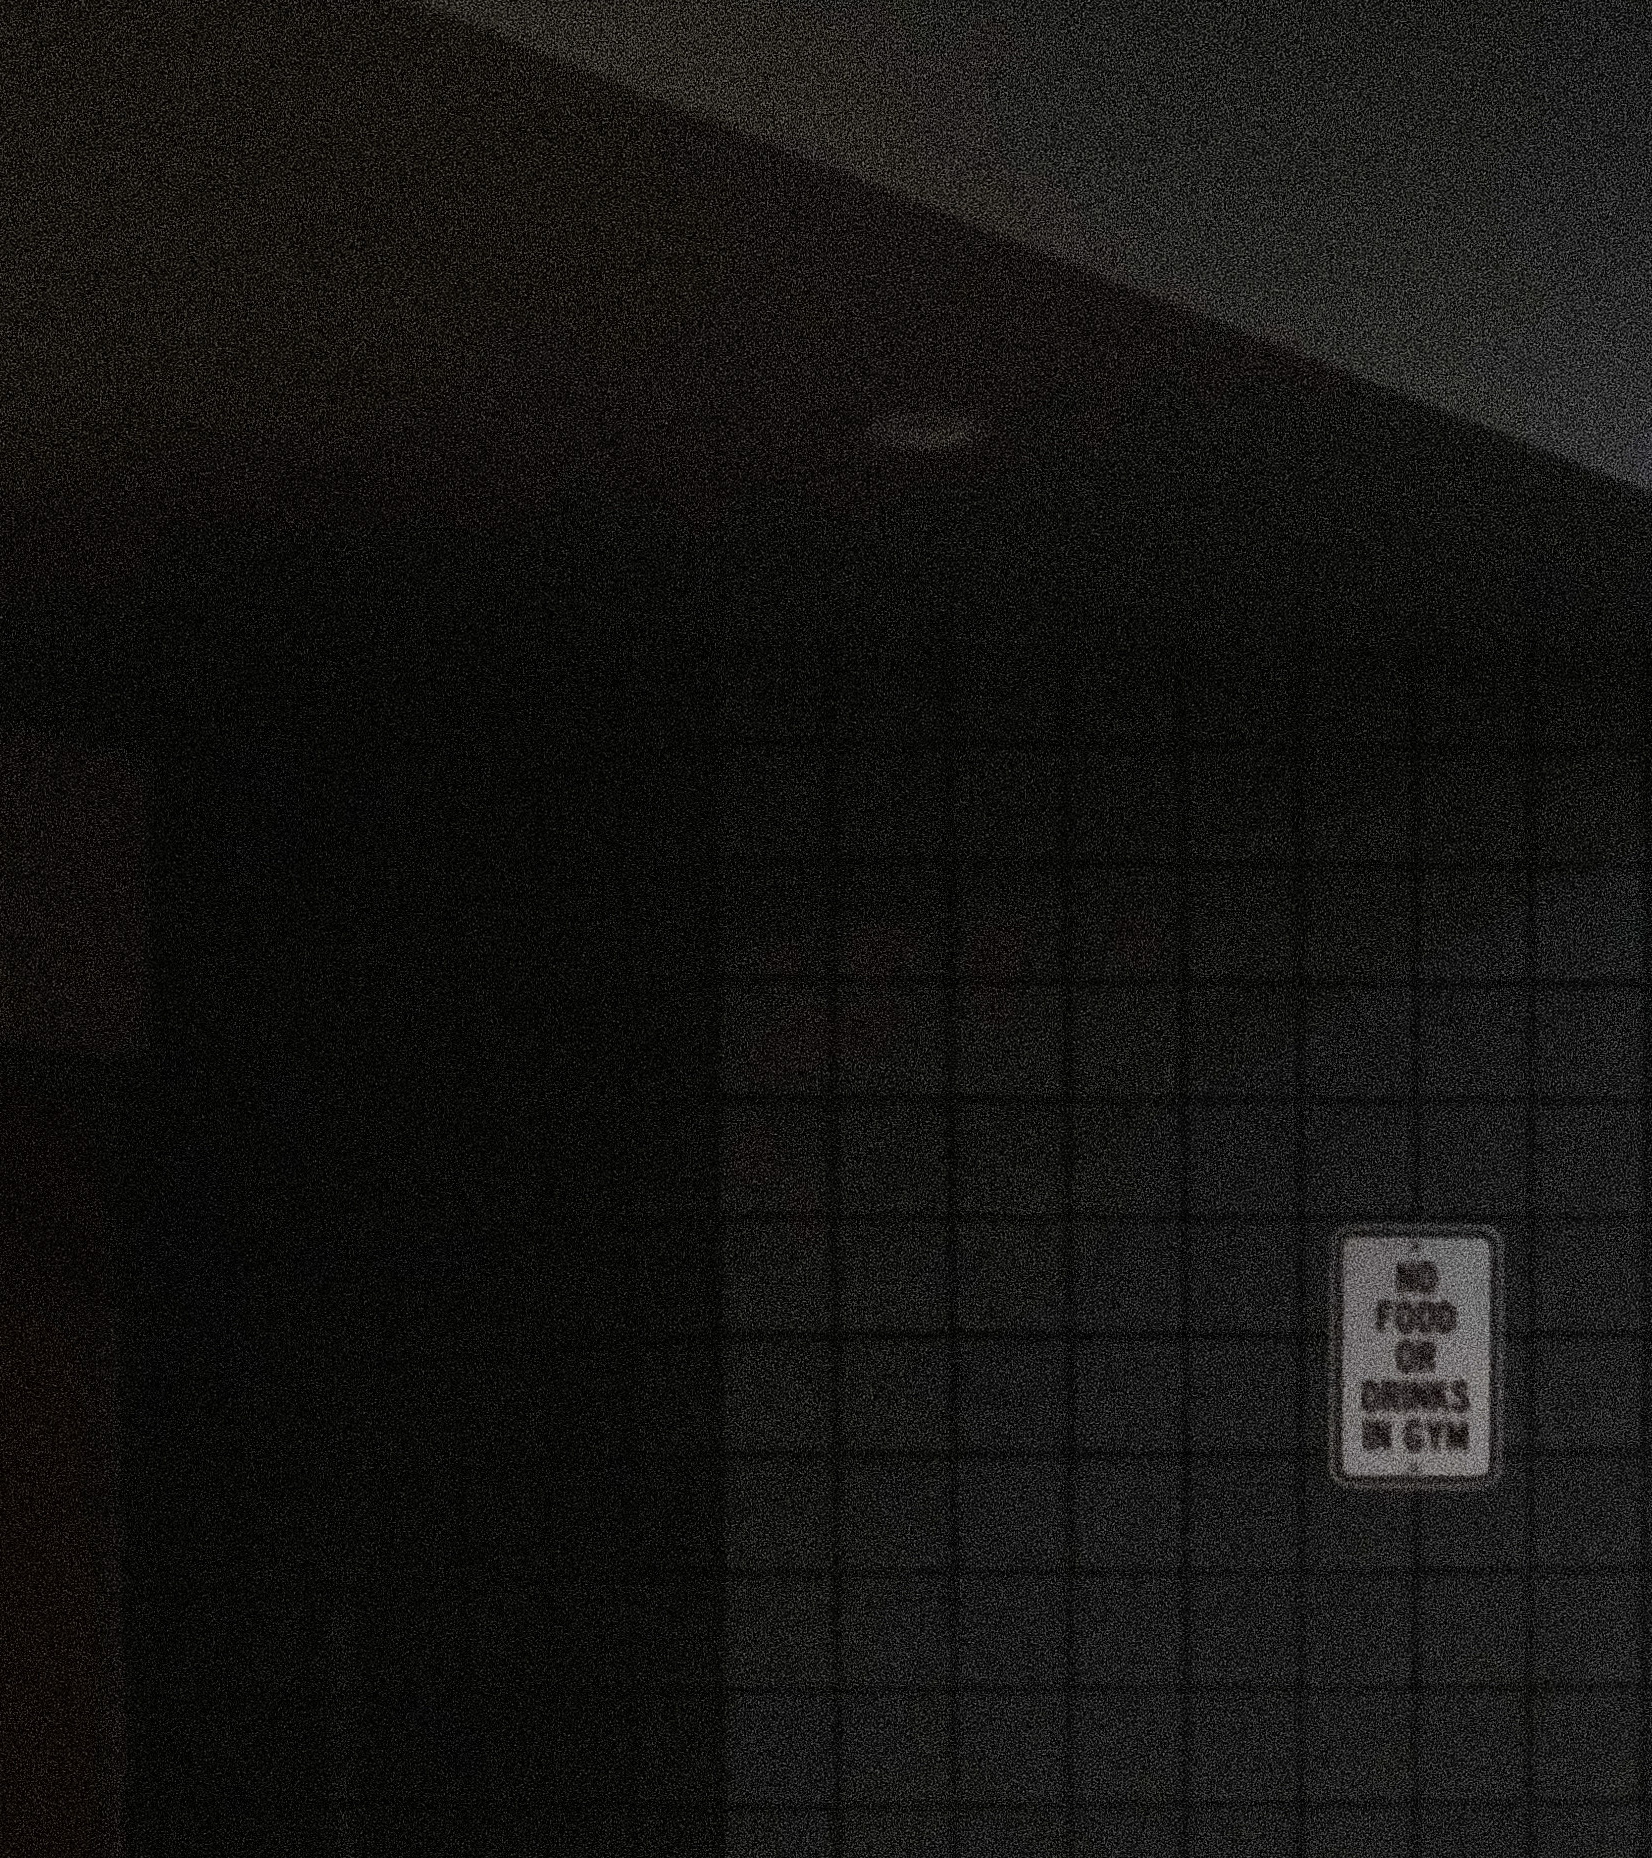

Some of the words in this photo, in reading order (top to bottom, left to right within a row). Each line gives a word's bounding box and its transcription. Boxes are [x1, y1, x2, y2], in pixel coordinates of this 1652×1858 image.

[1396, 1261, 1439, 1295] NO
[1375, 1300, 1458, 1335] FOOD
[1395, 1341, 1437, 1373] OR
[1361, 1380, 1470, 1413] DRINKS
[1362, 1420, 1392, 1450] IN
[1404, 1420, 1470, 1453] GYM
